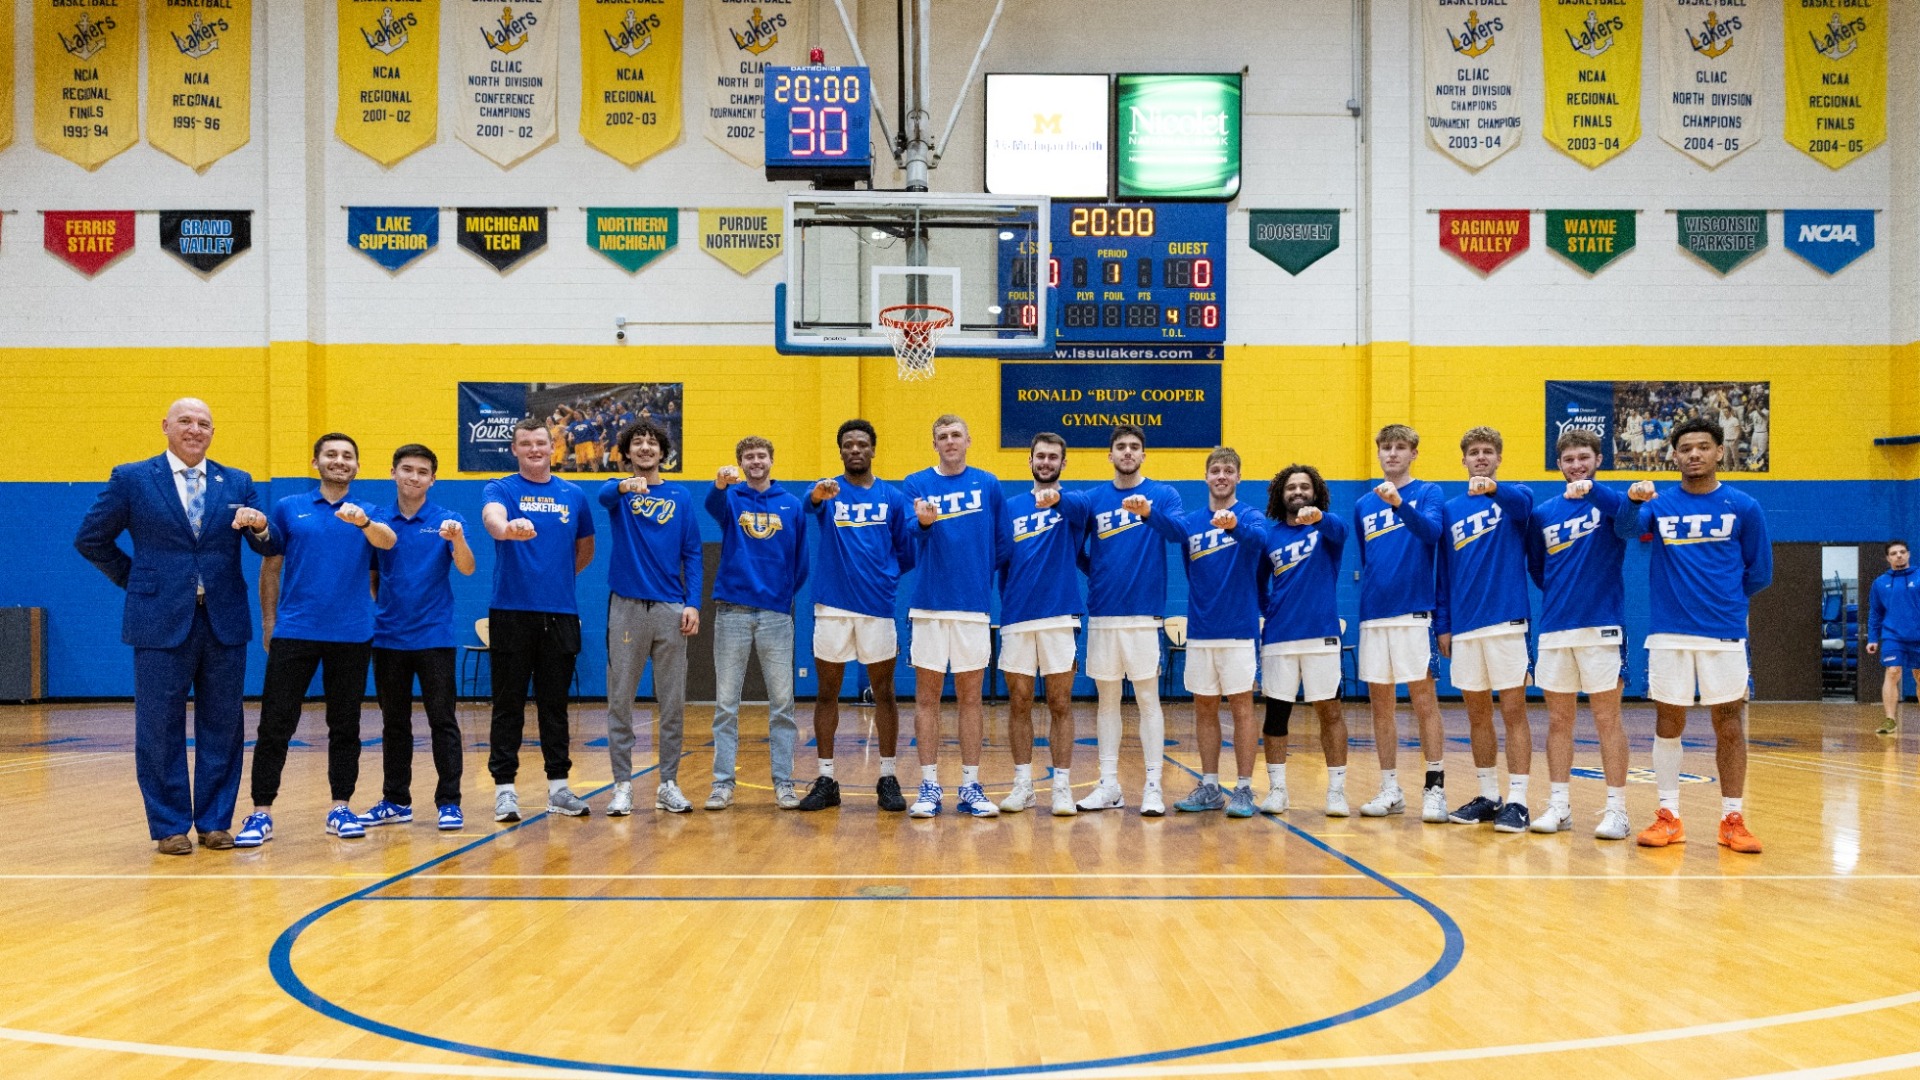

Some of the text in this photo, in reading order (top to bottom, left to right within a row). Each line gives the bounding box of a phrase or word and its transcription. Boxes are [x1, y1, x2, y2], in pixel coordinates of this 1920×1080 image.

[58, 16, 117, 54] Lakers
[170, 17, 229, 54] Lakers
[360, 11, 417, 49] Lakers
[480, 11, 537, 50] Lakers
[604, 12, 661, 52] Lakers
[729, 12, 787, 51] Lakers
[1446, 16, 1504, 52] Lakers
[1564, 15, 1624, 51] Lakers
[1684, 14, 1742, 52] Lakers
[1809, 15, 1867, 54] Lakers
[373, 66, 401, 79] NCAA
[490, 60, 523, 73] GLIAC
[616, 68, 644, 81] NCAA
[1457, 68, 1490, 81] GLIAC
[184, 72, 210, 85] NCAA
[468, 76, 543, 88] NORTH DIVISION
[717, 76, 749, 88] NORTH
[1579, 70, 1607, 82] NCAA
[1696, 71, 1728, 83] GLIAC
[1822, 73, 1850, 85] NCAA
[360, 90, 412, 103] REGIONAL
[604, 90, 656, 104] REGIONAL
[774, 75, 860, 103] 20:00
[1435, 85, 1512, 96] NORTH DIVISION
[172, 93, 223, 109] REGONAL
[474, 93, 535, 105] CONFERENCE
[730, 94, 765, 105] CHAMPI
[1451, 100, 1498, 111] CHAMPIONS
[1566, 92, 1620, 106] REGIONAL
[1673, 92, 1753, 107] NORTH DIVISION
[1809, 95, 1862, 108] REGIONAL
[480, 107, 531, 119] CHAMPIONS
[710, 107, 757, 119] TOURNAMENT
[1128, 105, 1230, 136] Nicolet
[1477, 116, 1521, 129] CHAMPIONS
[1573, 115, 1612, 128] FINALS
[1683, 115, 1742, 129] CHAMPIONS
[1816, 117, 1855, 130] FINALS
[788, 106, 848, 156] 30
[1448, 135, 1501, 149] 2003-04
[1567, 138, 1620, 151] 2003-04
[1809, 139, 1863, 153] 2004-05
[66, 220, 116, 237] FERRIS
[181, 219, 233, 237] GRAND
[376, 216, 412, 232] LAKE
[465, 216, 539, 232] MICHIGAN
[597, 216, 668, 233] NORTHERN
[719, 216, 768, 232] PURDUE
[1071, 208, 1154, 237] 20:00
[1451, 219, 1520, 236] SAGINAW
[1564, 219, 1617, 235] WAYNE
[1684, 216, 1759, 234] WISCONSIN
[1257, 224, 1333, 241] ROOSEVELT
[1798, 224, 1858, 243] NCAA
[67, 237, 115, 253] STATE
[180, 237, 235, 254] VALLEY
[358, 234, 428, 251] SUPERIOR
[484, 234, 521, 251] TECH
[600, 234, 666, 251] MICHIGAN
[706, 233, 782, 250] NORTHWEST
[1168, 242, 1208, 255] GUEST
[1459, 236, 1513, 253] VALLEY
[1568, 236, 1614, 253] STATE
[1689, 235, 1755, 251] PARKSIDE
[1097, 249, 1128, 259] PERIOD
[1194, 259, 1211, 287] 0
[1008, 291, 1035, 301] FOULS
[1077, 292, 1095, 301] PLYR
[1104, 292, 1125, 301] FOUL
[1138, 292, 1151, 301] PTS
[1190, 292, 1217, 301] FOULS
[1166, 309, 1178, 324] 4
[1204, 305, 1217, 328] 0
[1162, 328, 1186, 338] T.O.L.
[1054, 347, 1193, 359] w.lssulakers.com
[1017, 389, 1082, 402] RONALD
[1141, 389, 1205, 402] COOPER
[1062, 414, 1162, 427] GYMNASIUM
[1574, 415, 1606, 423] MAKE IT
[521, 495, 555, 504] LAKE STATE
[927, 489, 982, 514] ETJ
[834, 501, 889, 522] ETJ
[1451, 502, 1503, 546] ETJ
[1543, 507, 1601, 548] ETJ
[1657, 513, 1737, 539] ETJ
[1269, 530, 1319, 571] ETJ
